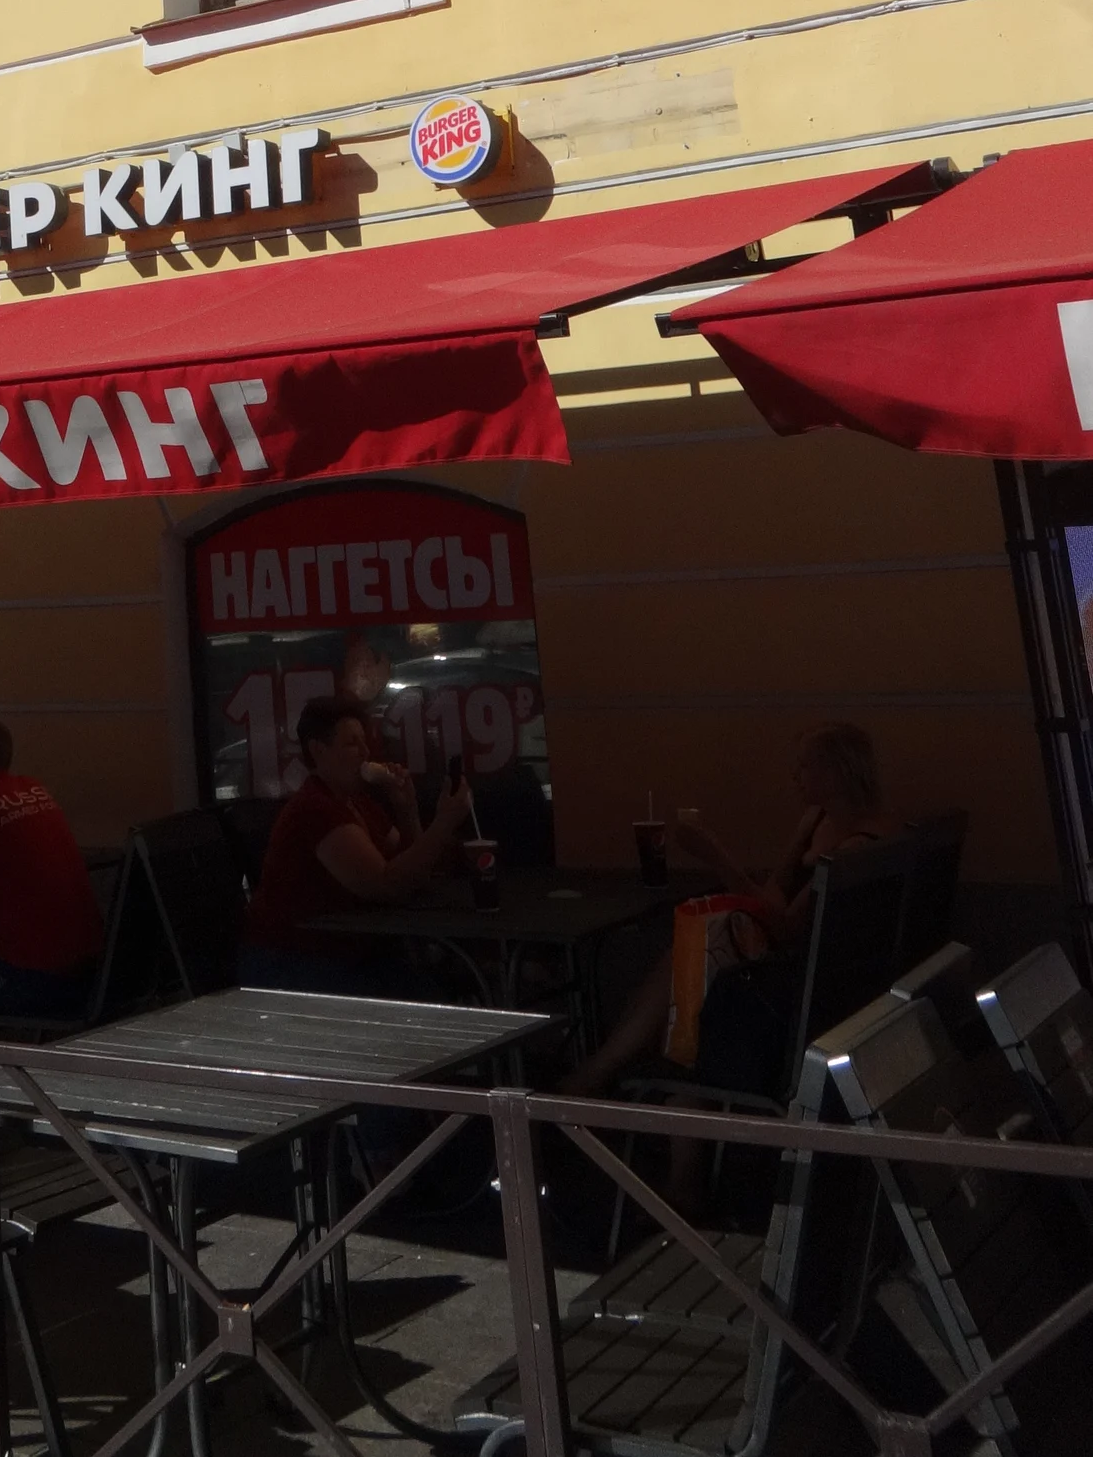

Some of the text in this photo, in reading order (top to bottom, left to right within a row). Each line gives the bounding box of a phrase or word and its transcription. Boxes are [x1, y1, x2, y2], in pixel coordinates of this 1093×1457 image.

[418, 106, 477, 146] BURGER
[421, 120, 481, 167] KING
[84, 128, 318, 238] КИНГ
[209, 533, 515, 621] НАГГЕТСЫ
